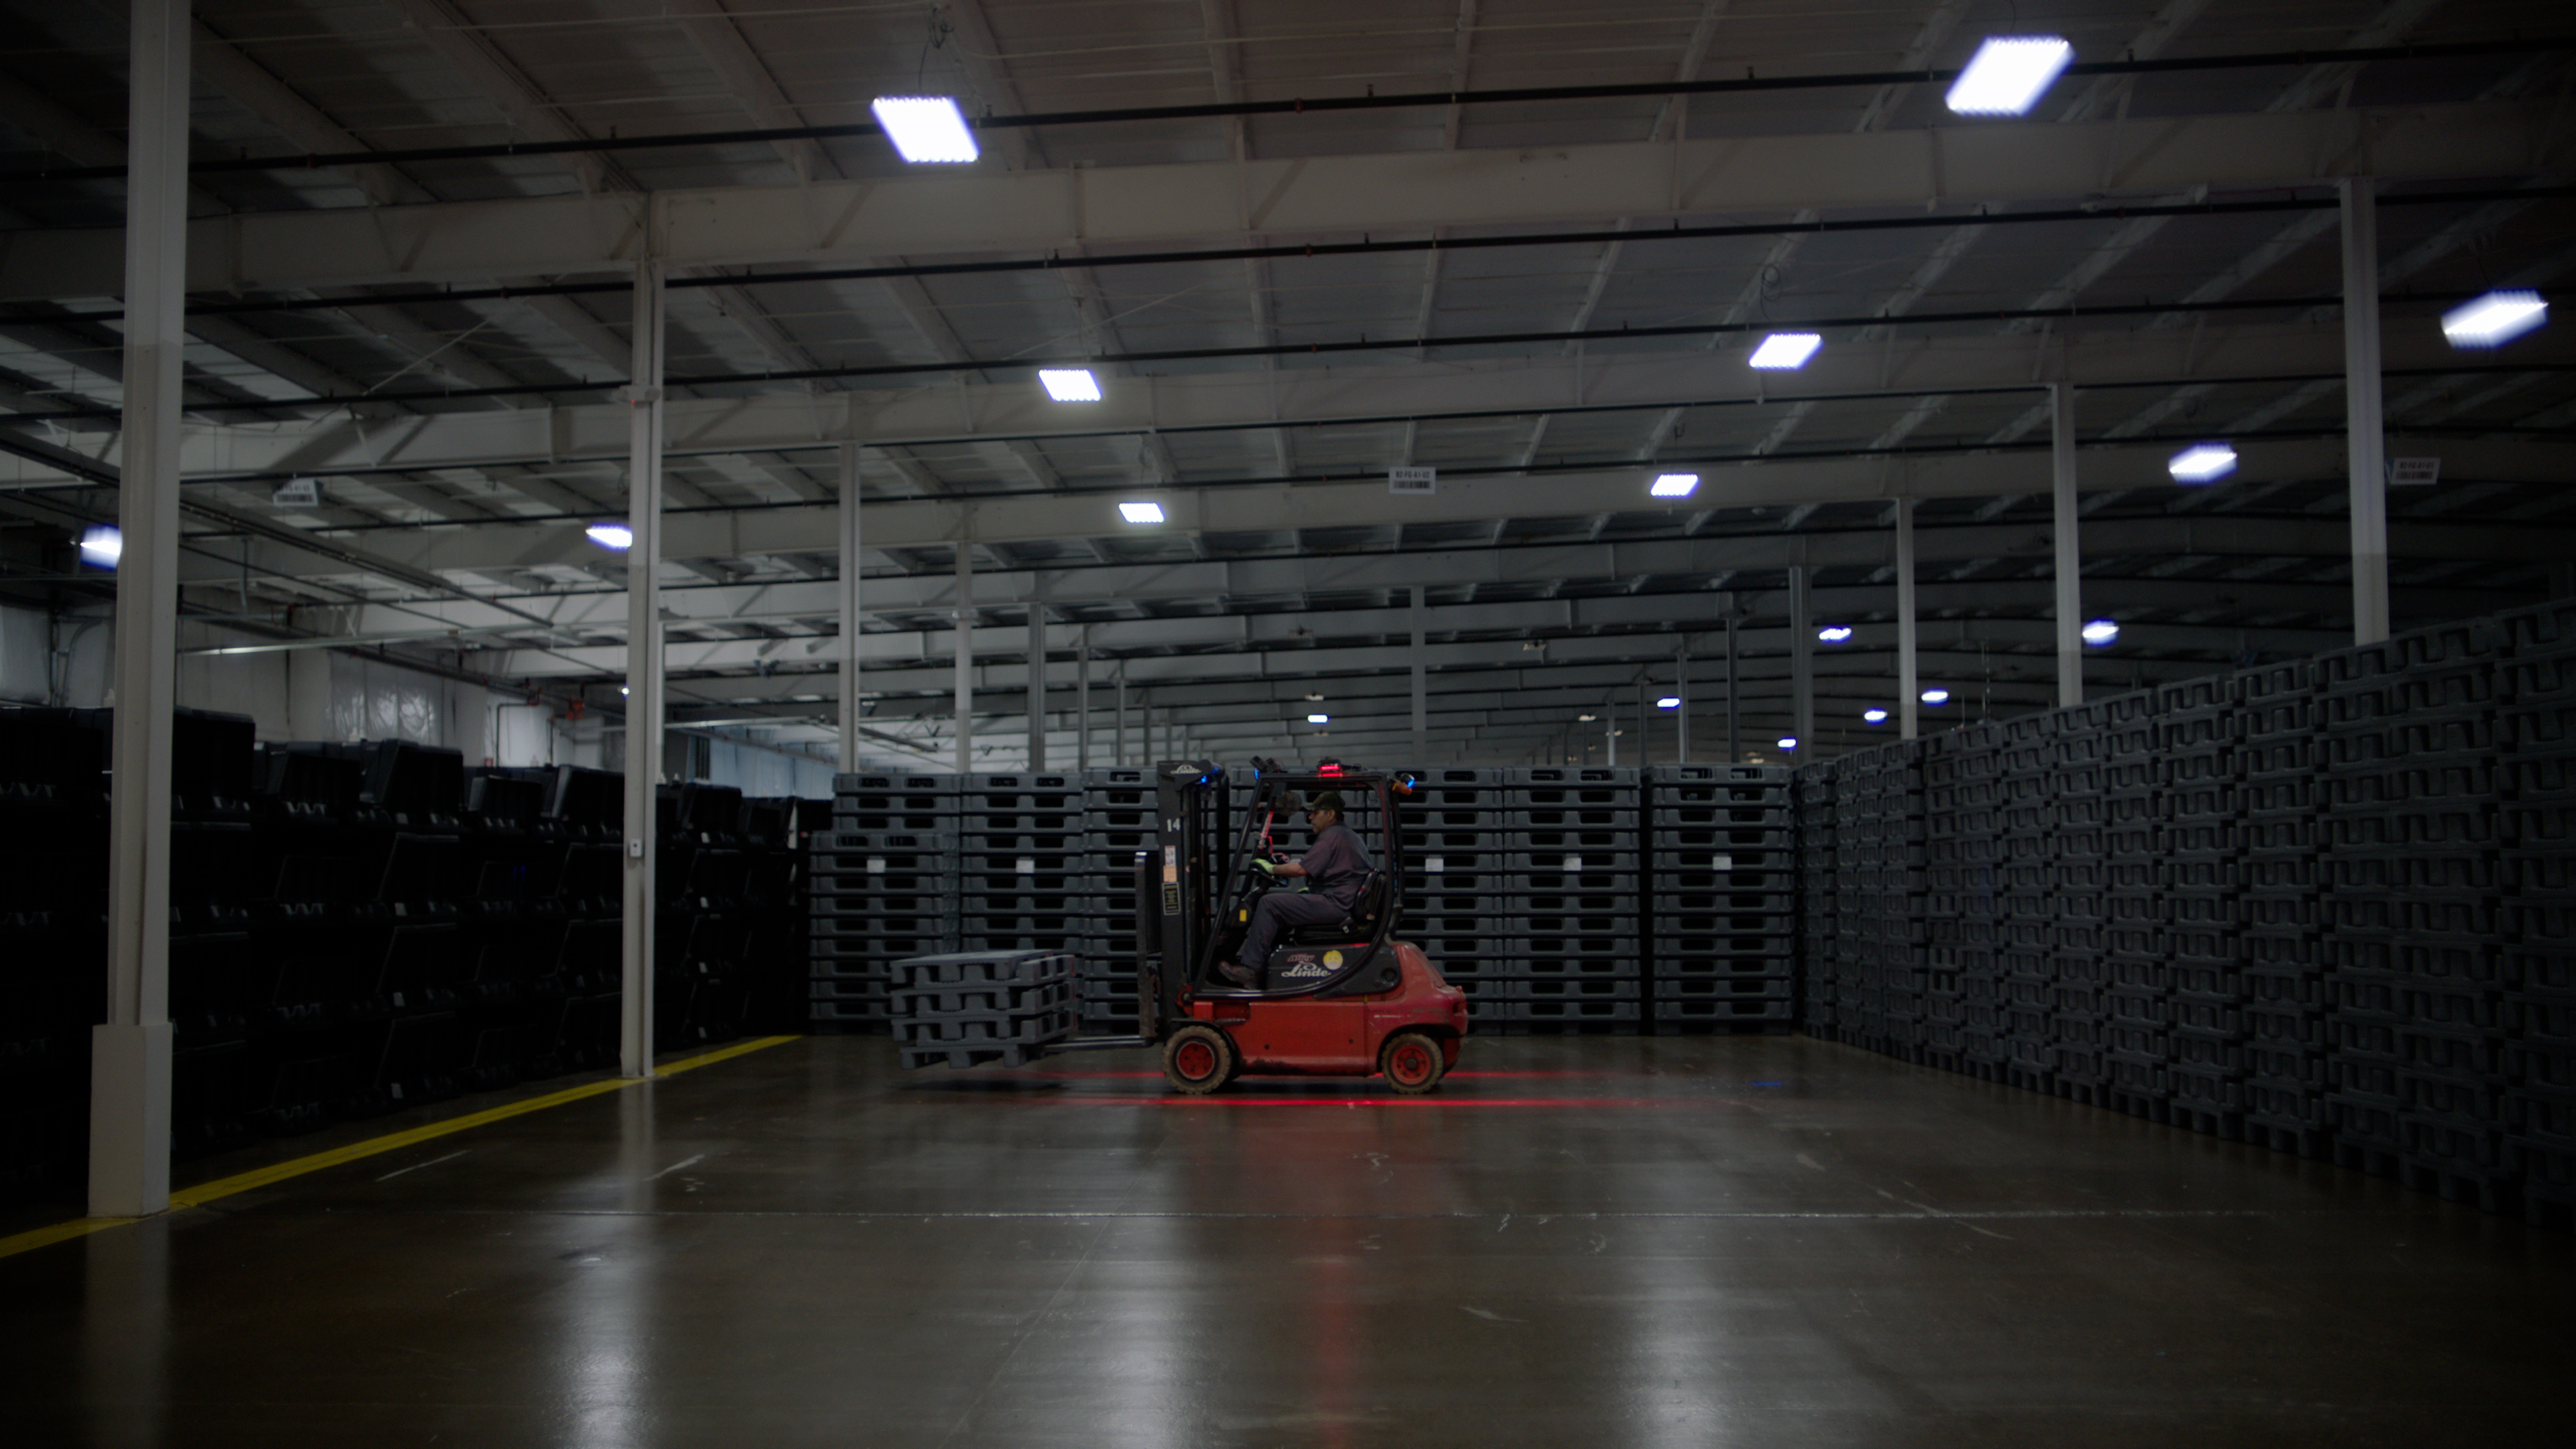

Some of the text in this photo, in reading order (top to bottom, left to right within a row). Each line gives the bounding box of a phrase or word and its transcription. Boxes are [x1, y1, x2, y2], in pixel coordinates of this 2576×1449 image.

[1170, 764, 1202, 774] Linde
[1166, 818, 1181, 832] 14
[1281, 961, 1331, 977] Linde
